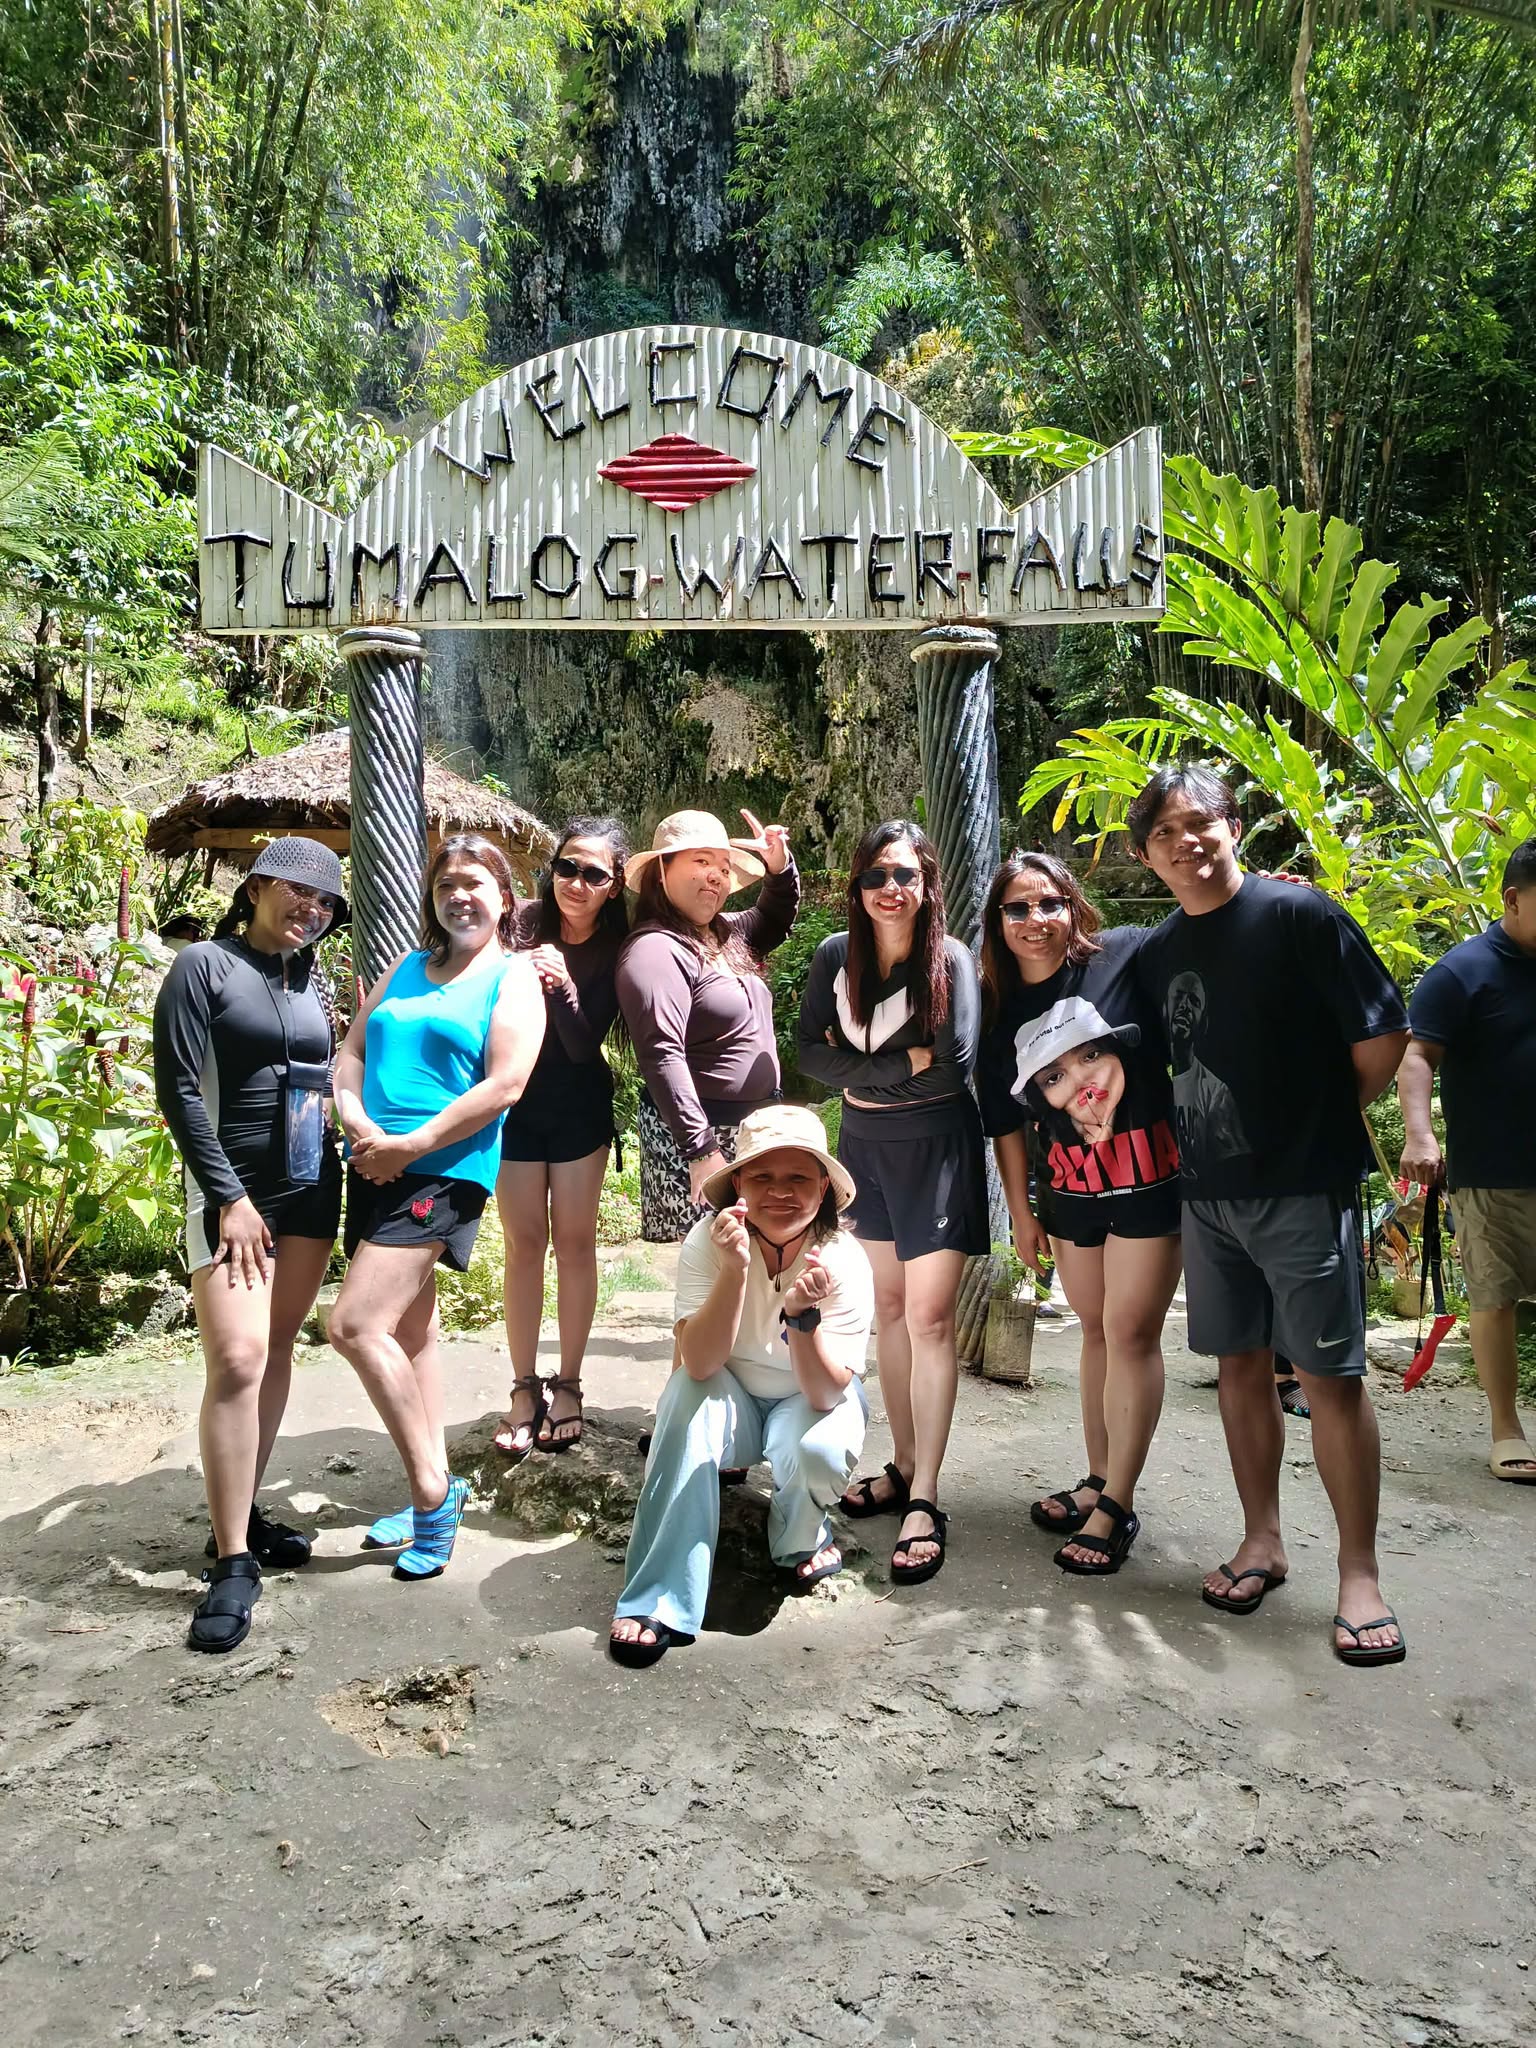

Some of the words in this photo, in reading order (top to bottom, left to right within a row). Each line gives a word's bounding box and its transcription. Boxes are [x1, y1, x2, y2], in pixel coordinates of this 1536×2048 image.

[434, 341, 907, 483] WELCOME
[204, 529, 639, 610] TUMALOG
[670, 530, 958, 606] WATER
[977, 521, 1162, 597] FALLS
[1048, 1120, 1179, 1193] OLIVIA
